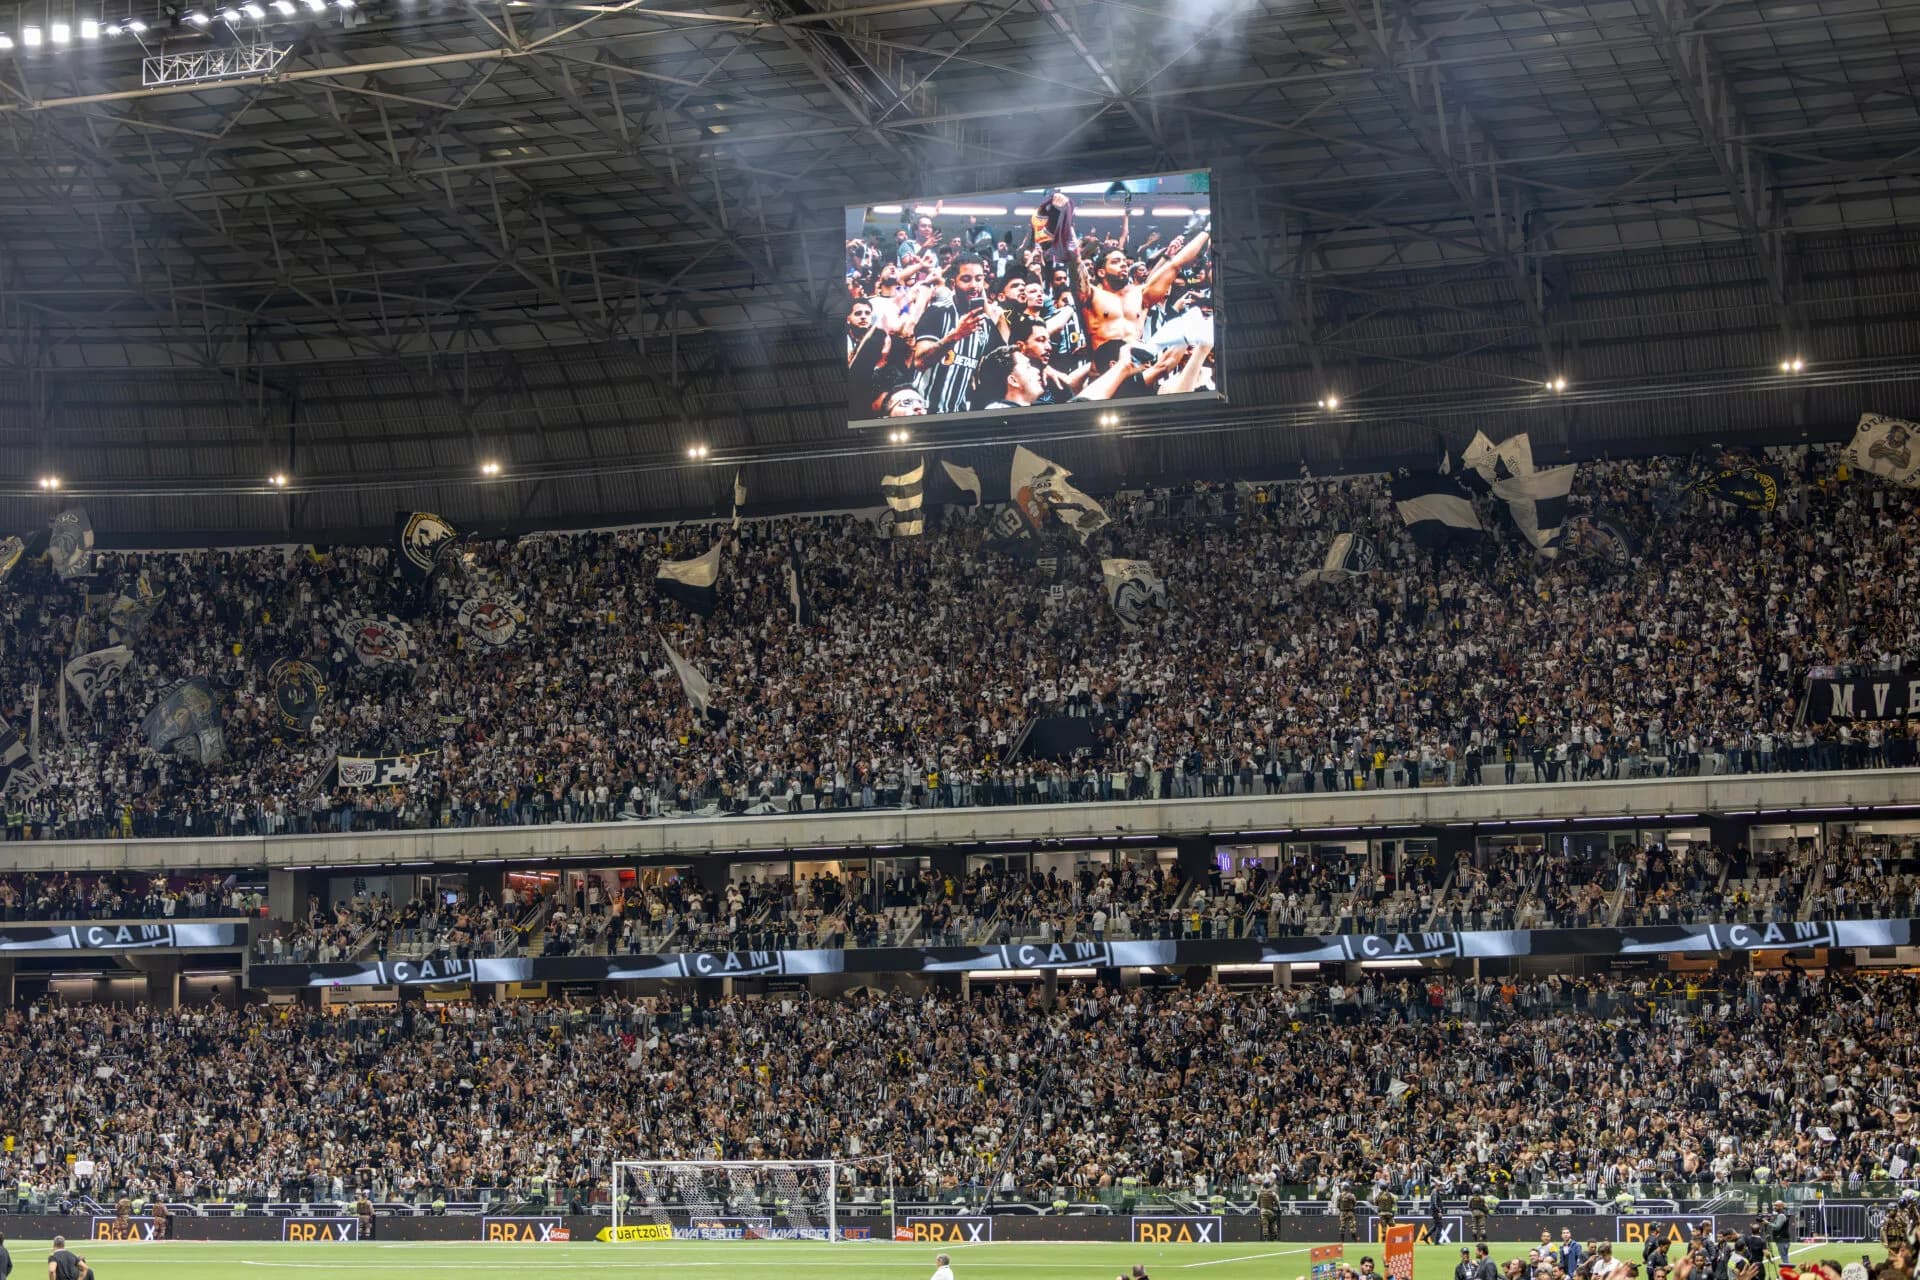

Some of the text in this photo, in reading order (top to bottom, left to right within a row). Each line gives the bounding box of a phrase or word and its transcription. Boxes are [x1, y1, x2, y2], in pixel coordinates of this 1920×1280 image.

[88, 924, 161, 945] CAM
[1362, 932, 1446, 956] CAM
[1729, 921, 1819, 946] CAM
[696, 951, 769, 974] CAM
[1018, 942, 1096, 965] CAM
[393, 959, 463, 981] CAM
[289, 1223, 352, 1241] BRAX
[489, 1223, 554, 1241] BRAX
[799, 1228, 842, 1240] SORT
[914, 1223, 984, 1242] BRAX
[1140, 1223, 1213, 1242] BRAX
